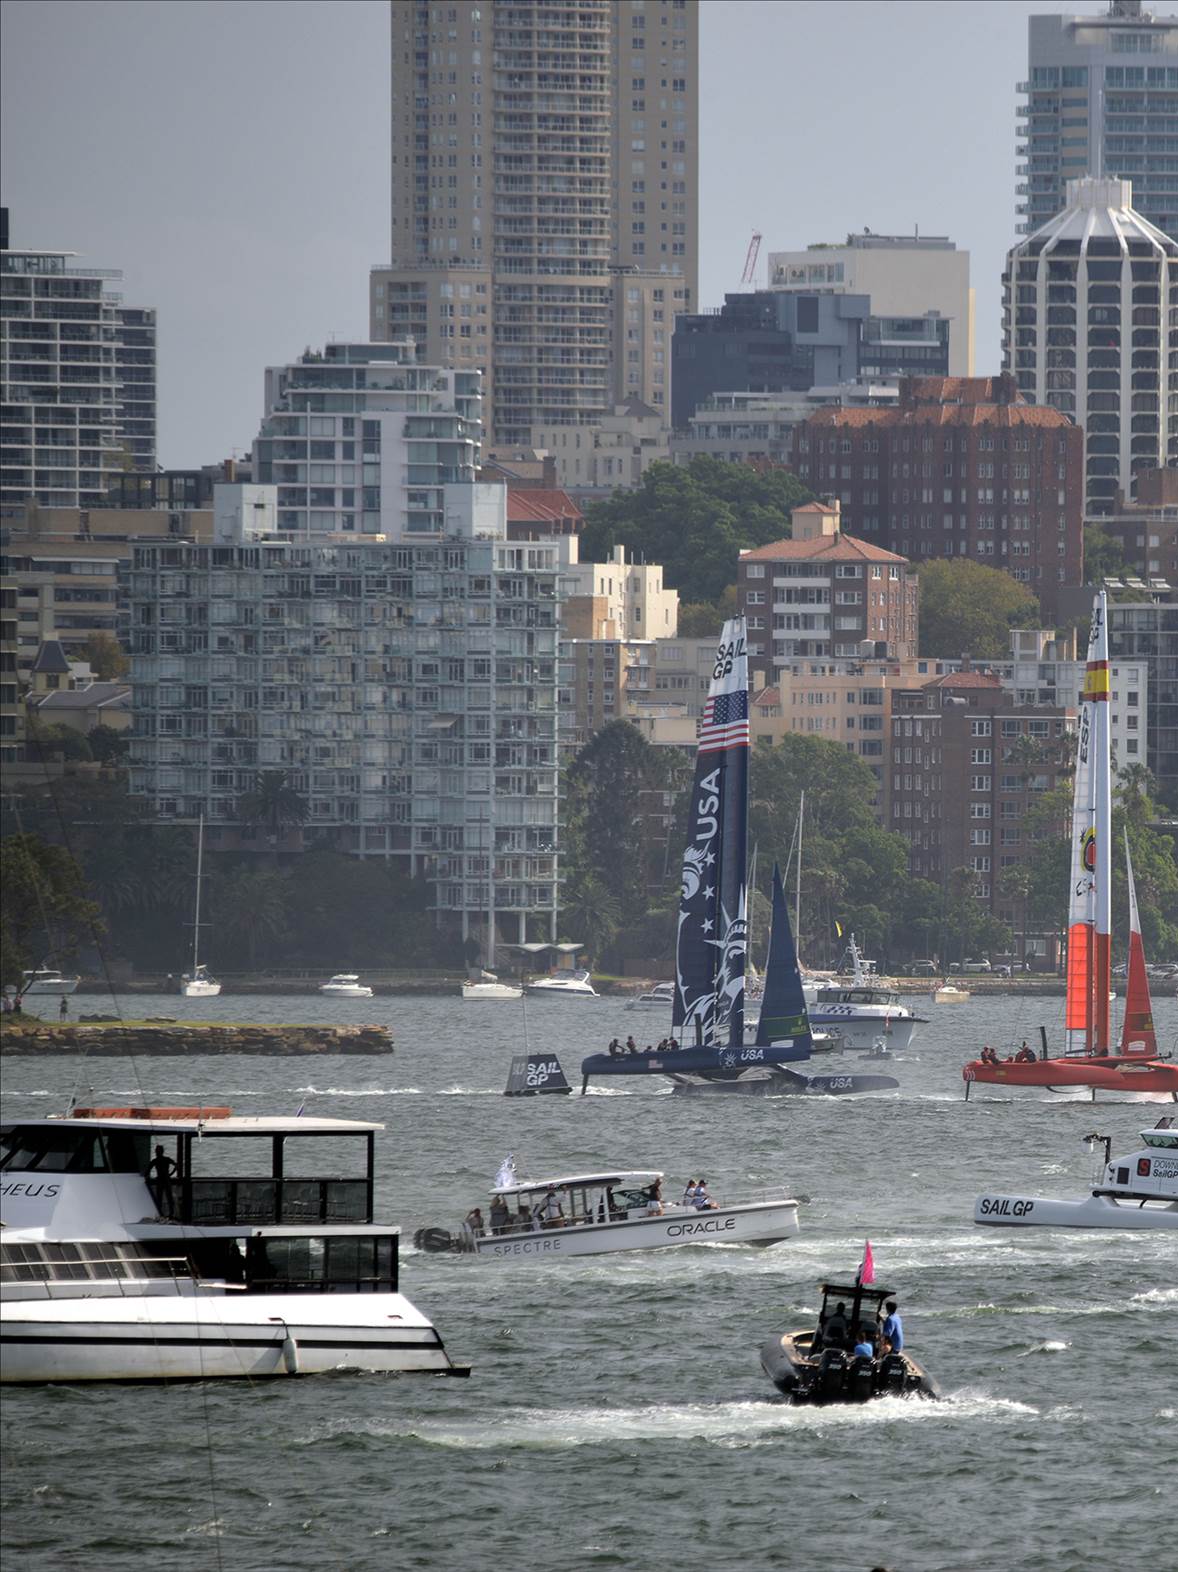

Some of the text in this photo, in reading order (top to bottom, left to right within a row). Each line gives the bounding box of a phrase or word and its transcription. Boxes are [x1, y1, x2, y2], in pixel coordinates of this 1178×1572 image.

[716, 638, 746, 661] SAIL
[713, 660, 733, 680] GP
[1080, 705, 1089, 764] ESP
[696, 767, 721, 840] USA
[741, 1049, 764, 1060] USA
[527, 1062, 561, 1075] SAIL
[527, 1074, 549, 1086] GP
[830, 1077, 853, 1089] USA
[1153, 1169, 1178, 1178] SailGP
[667, 1218, 736, 1237] ORACLE
[494, 1239, 561, 1257] SPECTRE
